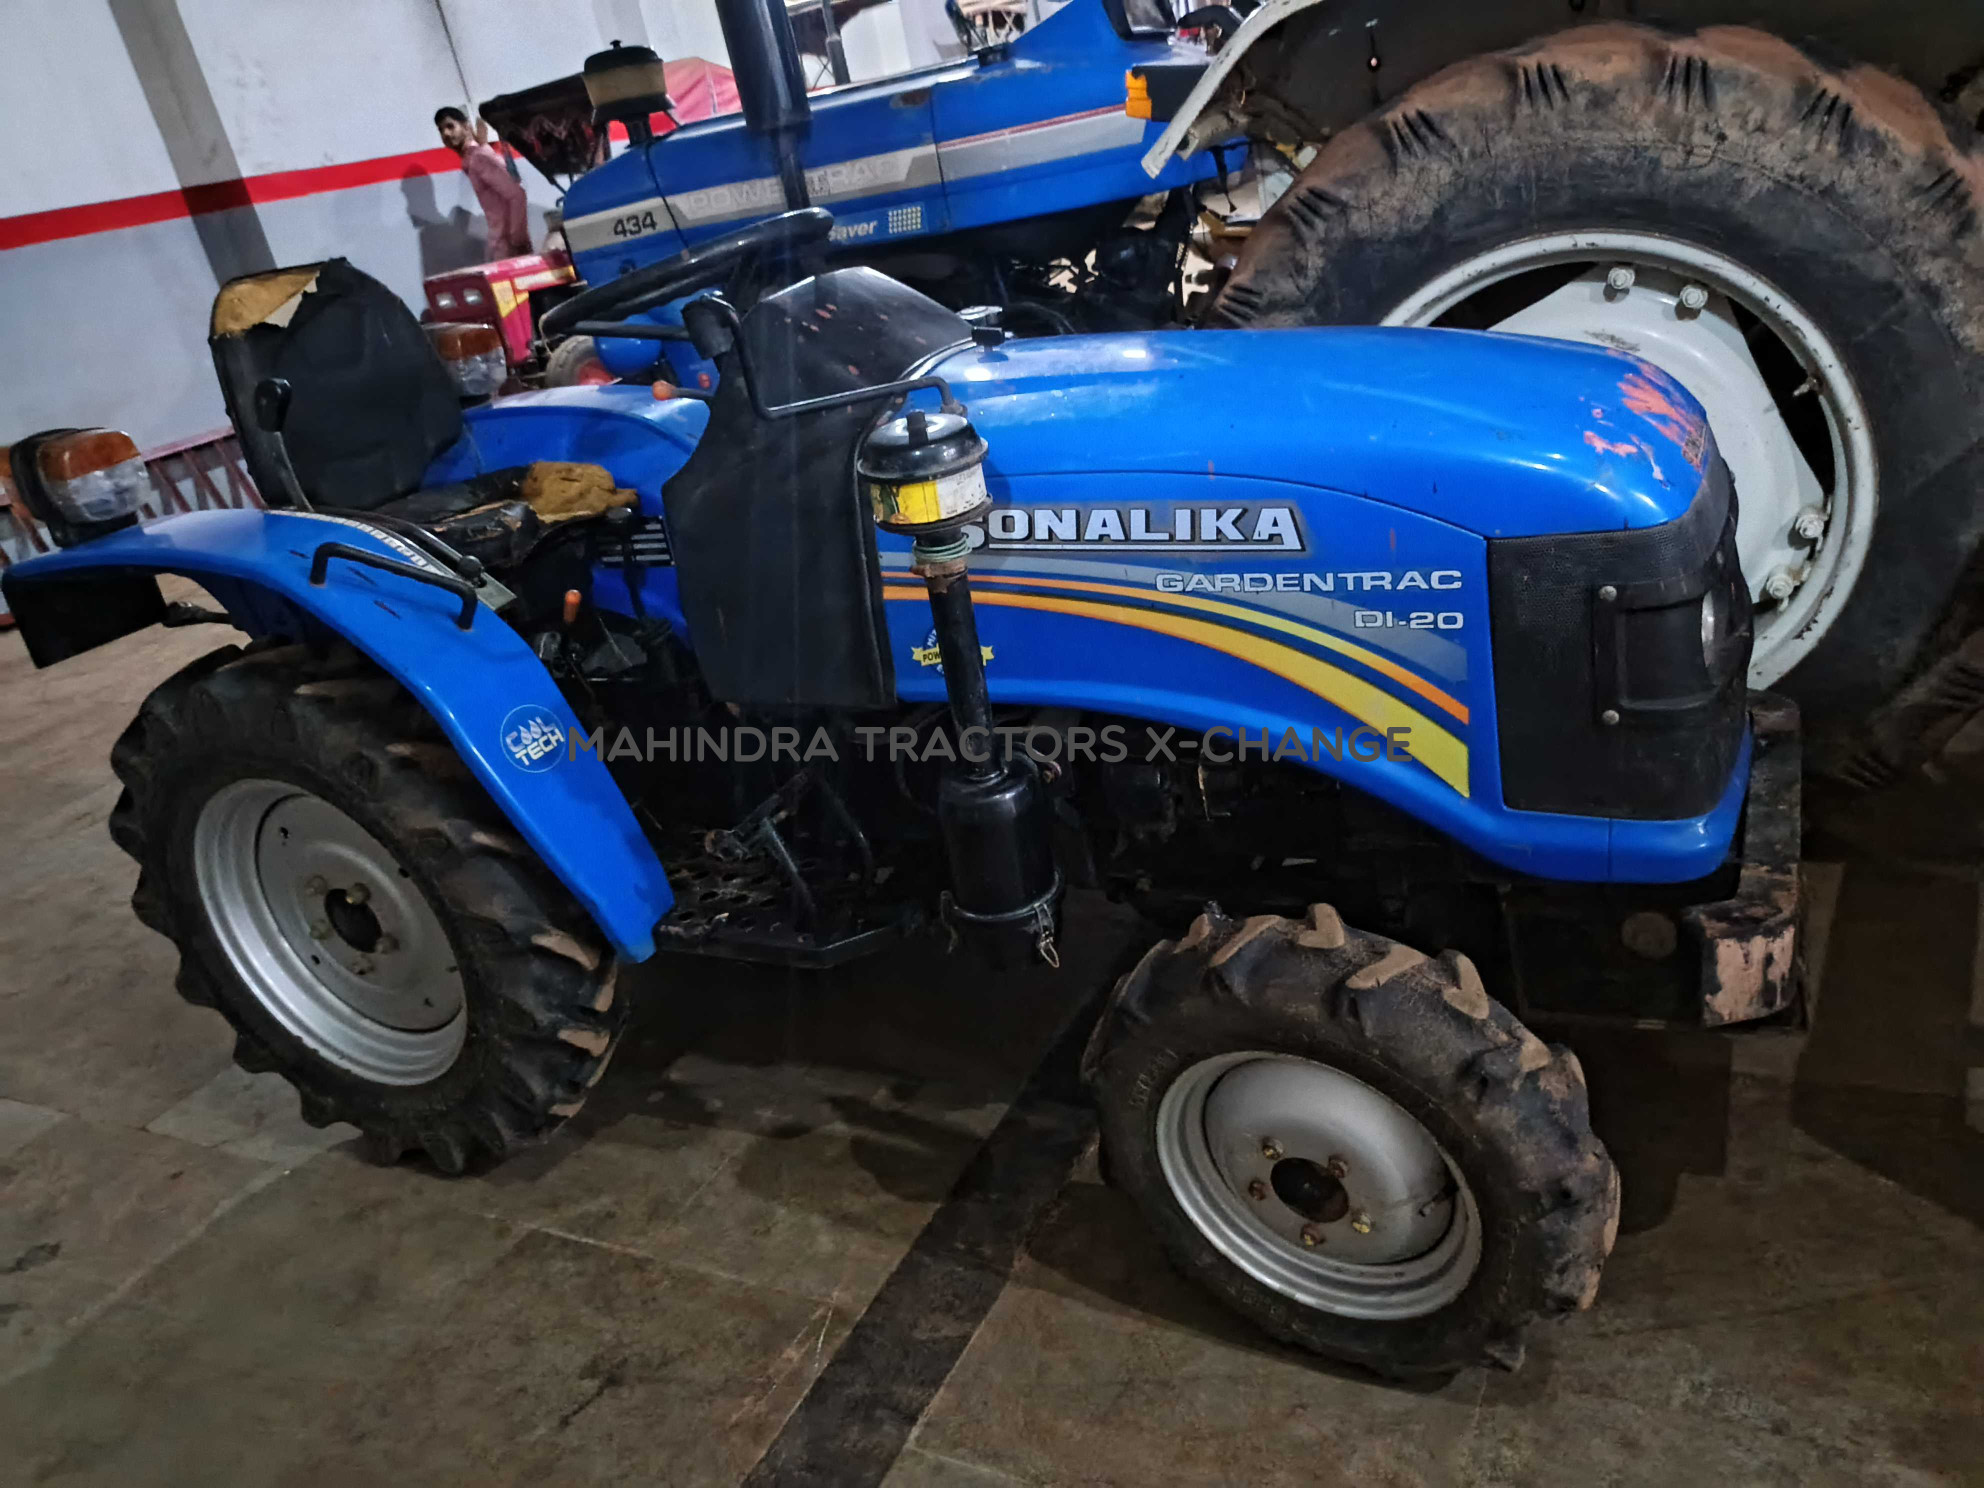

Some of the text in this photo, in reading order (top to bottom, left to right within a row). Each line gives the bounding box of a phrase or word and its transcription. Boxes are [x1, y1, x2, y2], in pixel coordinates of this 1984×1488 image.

[688, 158, 899, 209] POWETRAC
[613, 211, 657, 237] 434
[1154, 570, 1463, 592] GARDENTRAC
[1354, 610, 1464, 629] DI-20
[505, 716, 557, 753] COOL
[515, 728, 566, 766] TECH
